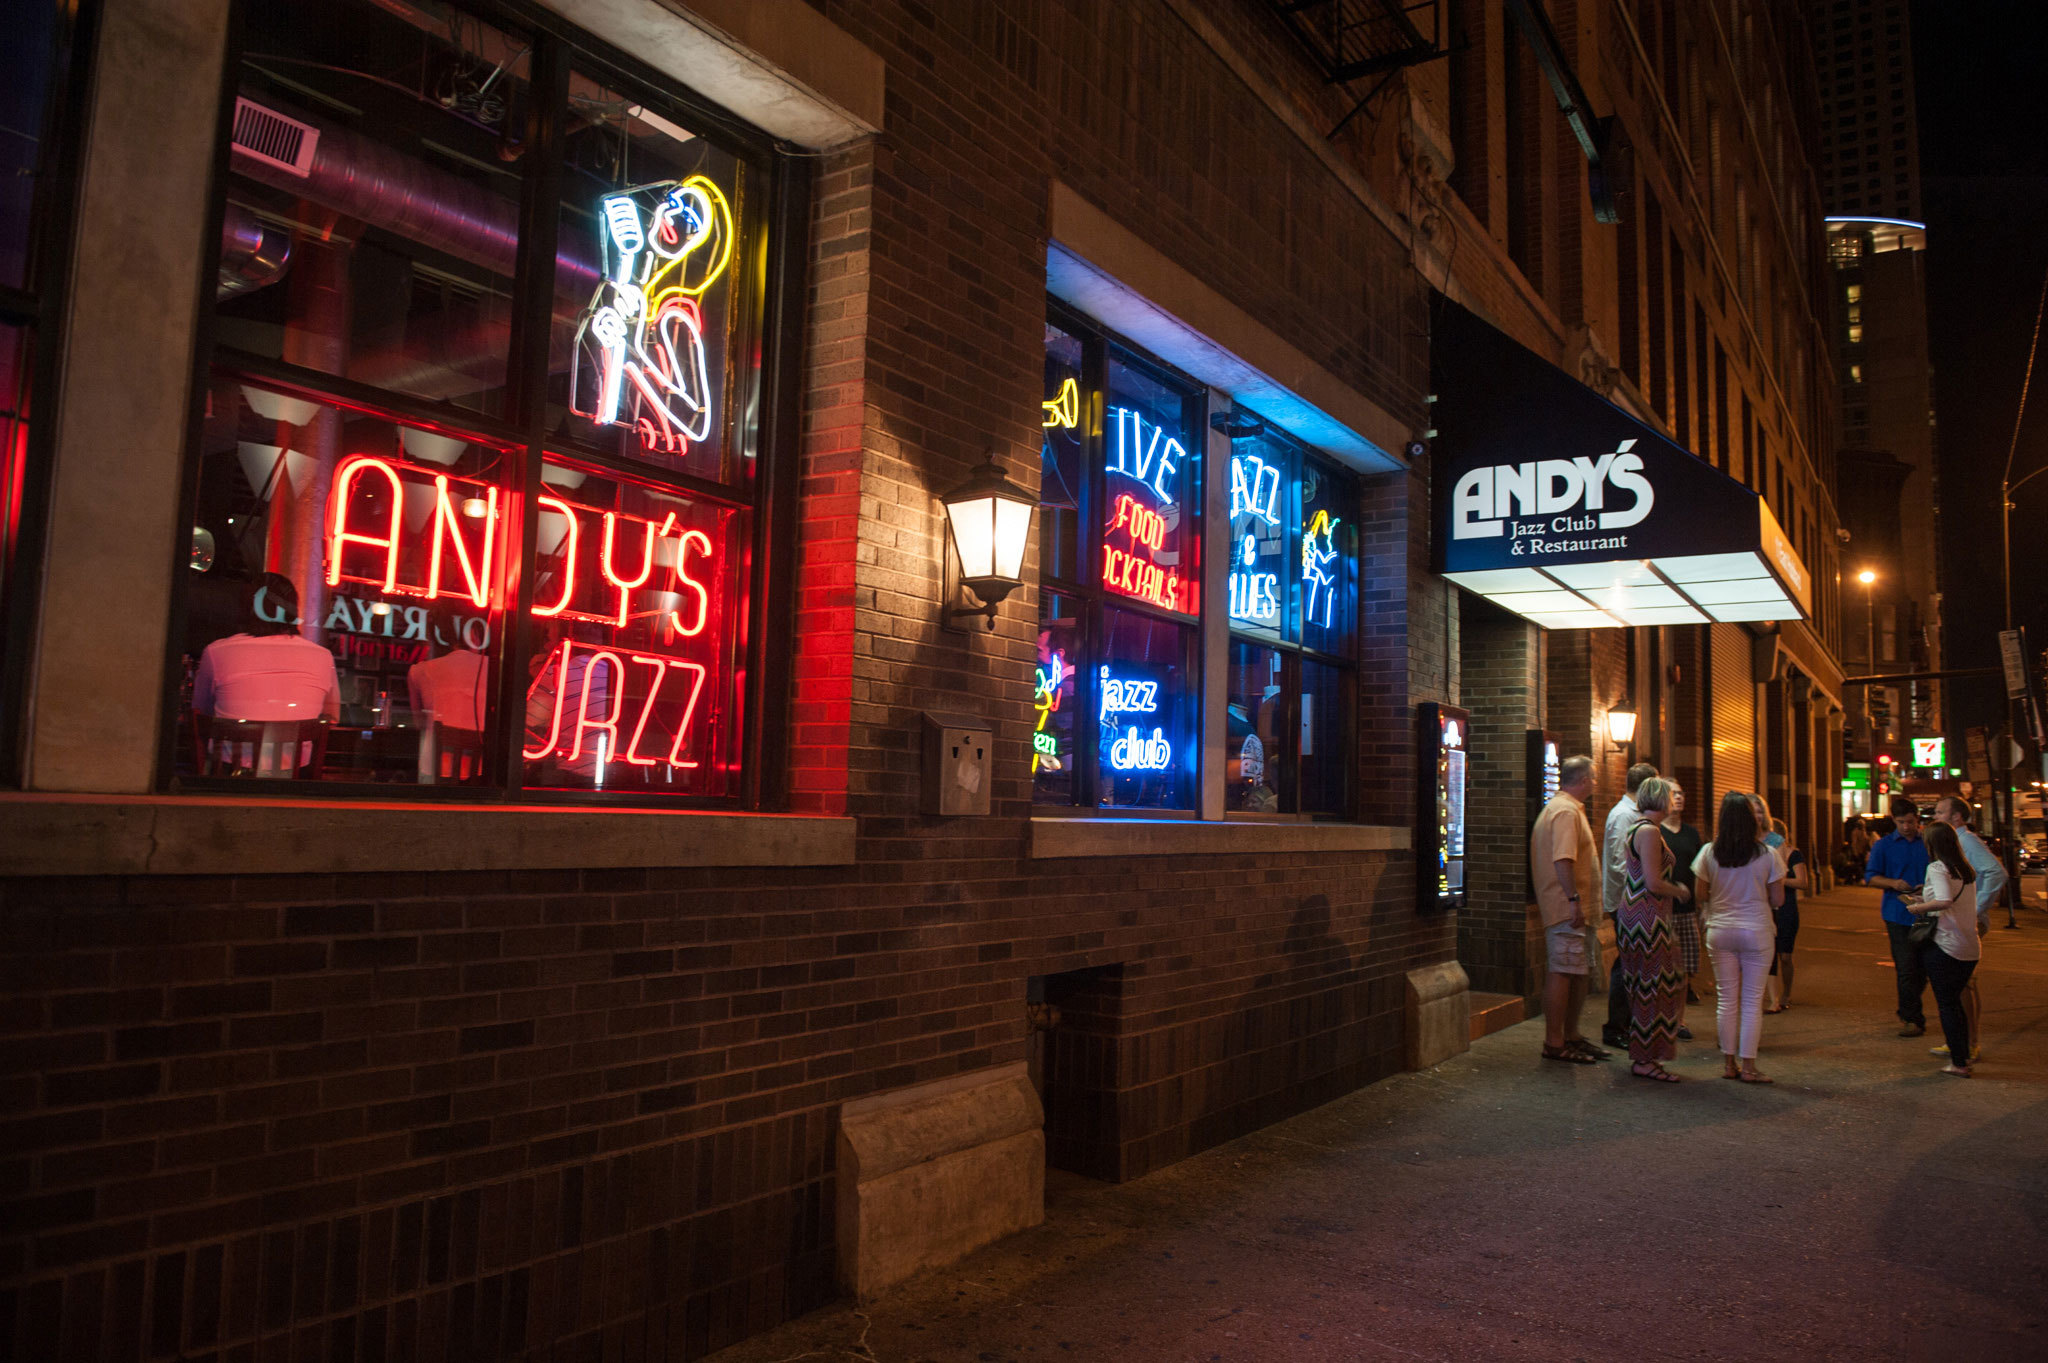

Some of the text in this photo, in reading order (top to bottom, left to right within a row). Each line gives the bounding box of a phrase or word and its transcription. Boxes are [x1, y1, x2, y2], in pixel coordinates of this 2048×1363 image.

[1105, 408, 1186, 504] IVE
[1230, 455, 1280, 525] AZZ
[1453, 439, 1655, 540] ANDY'S
[326, 459, 711, 636] ANDY'S
[1117, 495, 1165, 550] FOOD
[1510, 515, 1596, 540] Jazz Club
[1511, 535, 1628, 556] & Restaurant
[1229, 572, 1277, 619] LUES
[523, 640, 705, 768] JAZZ
[1100, 665, 1158, 721] jazz
[1111, 726, 1171, 770] club
